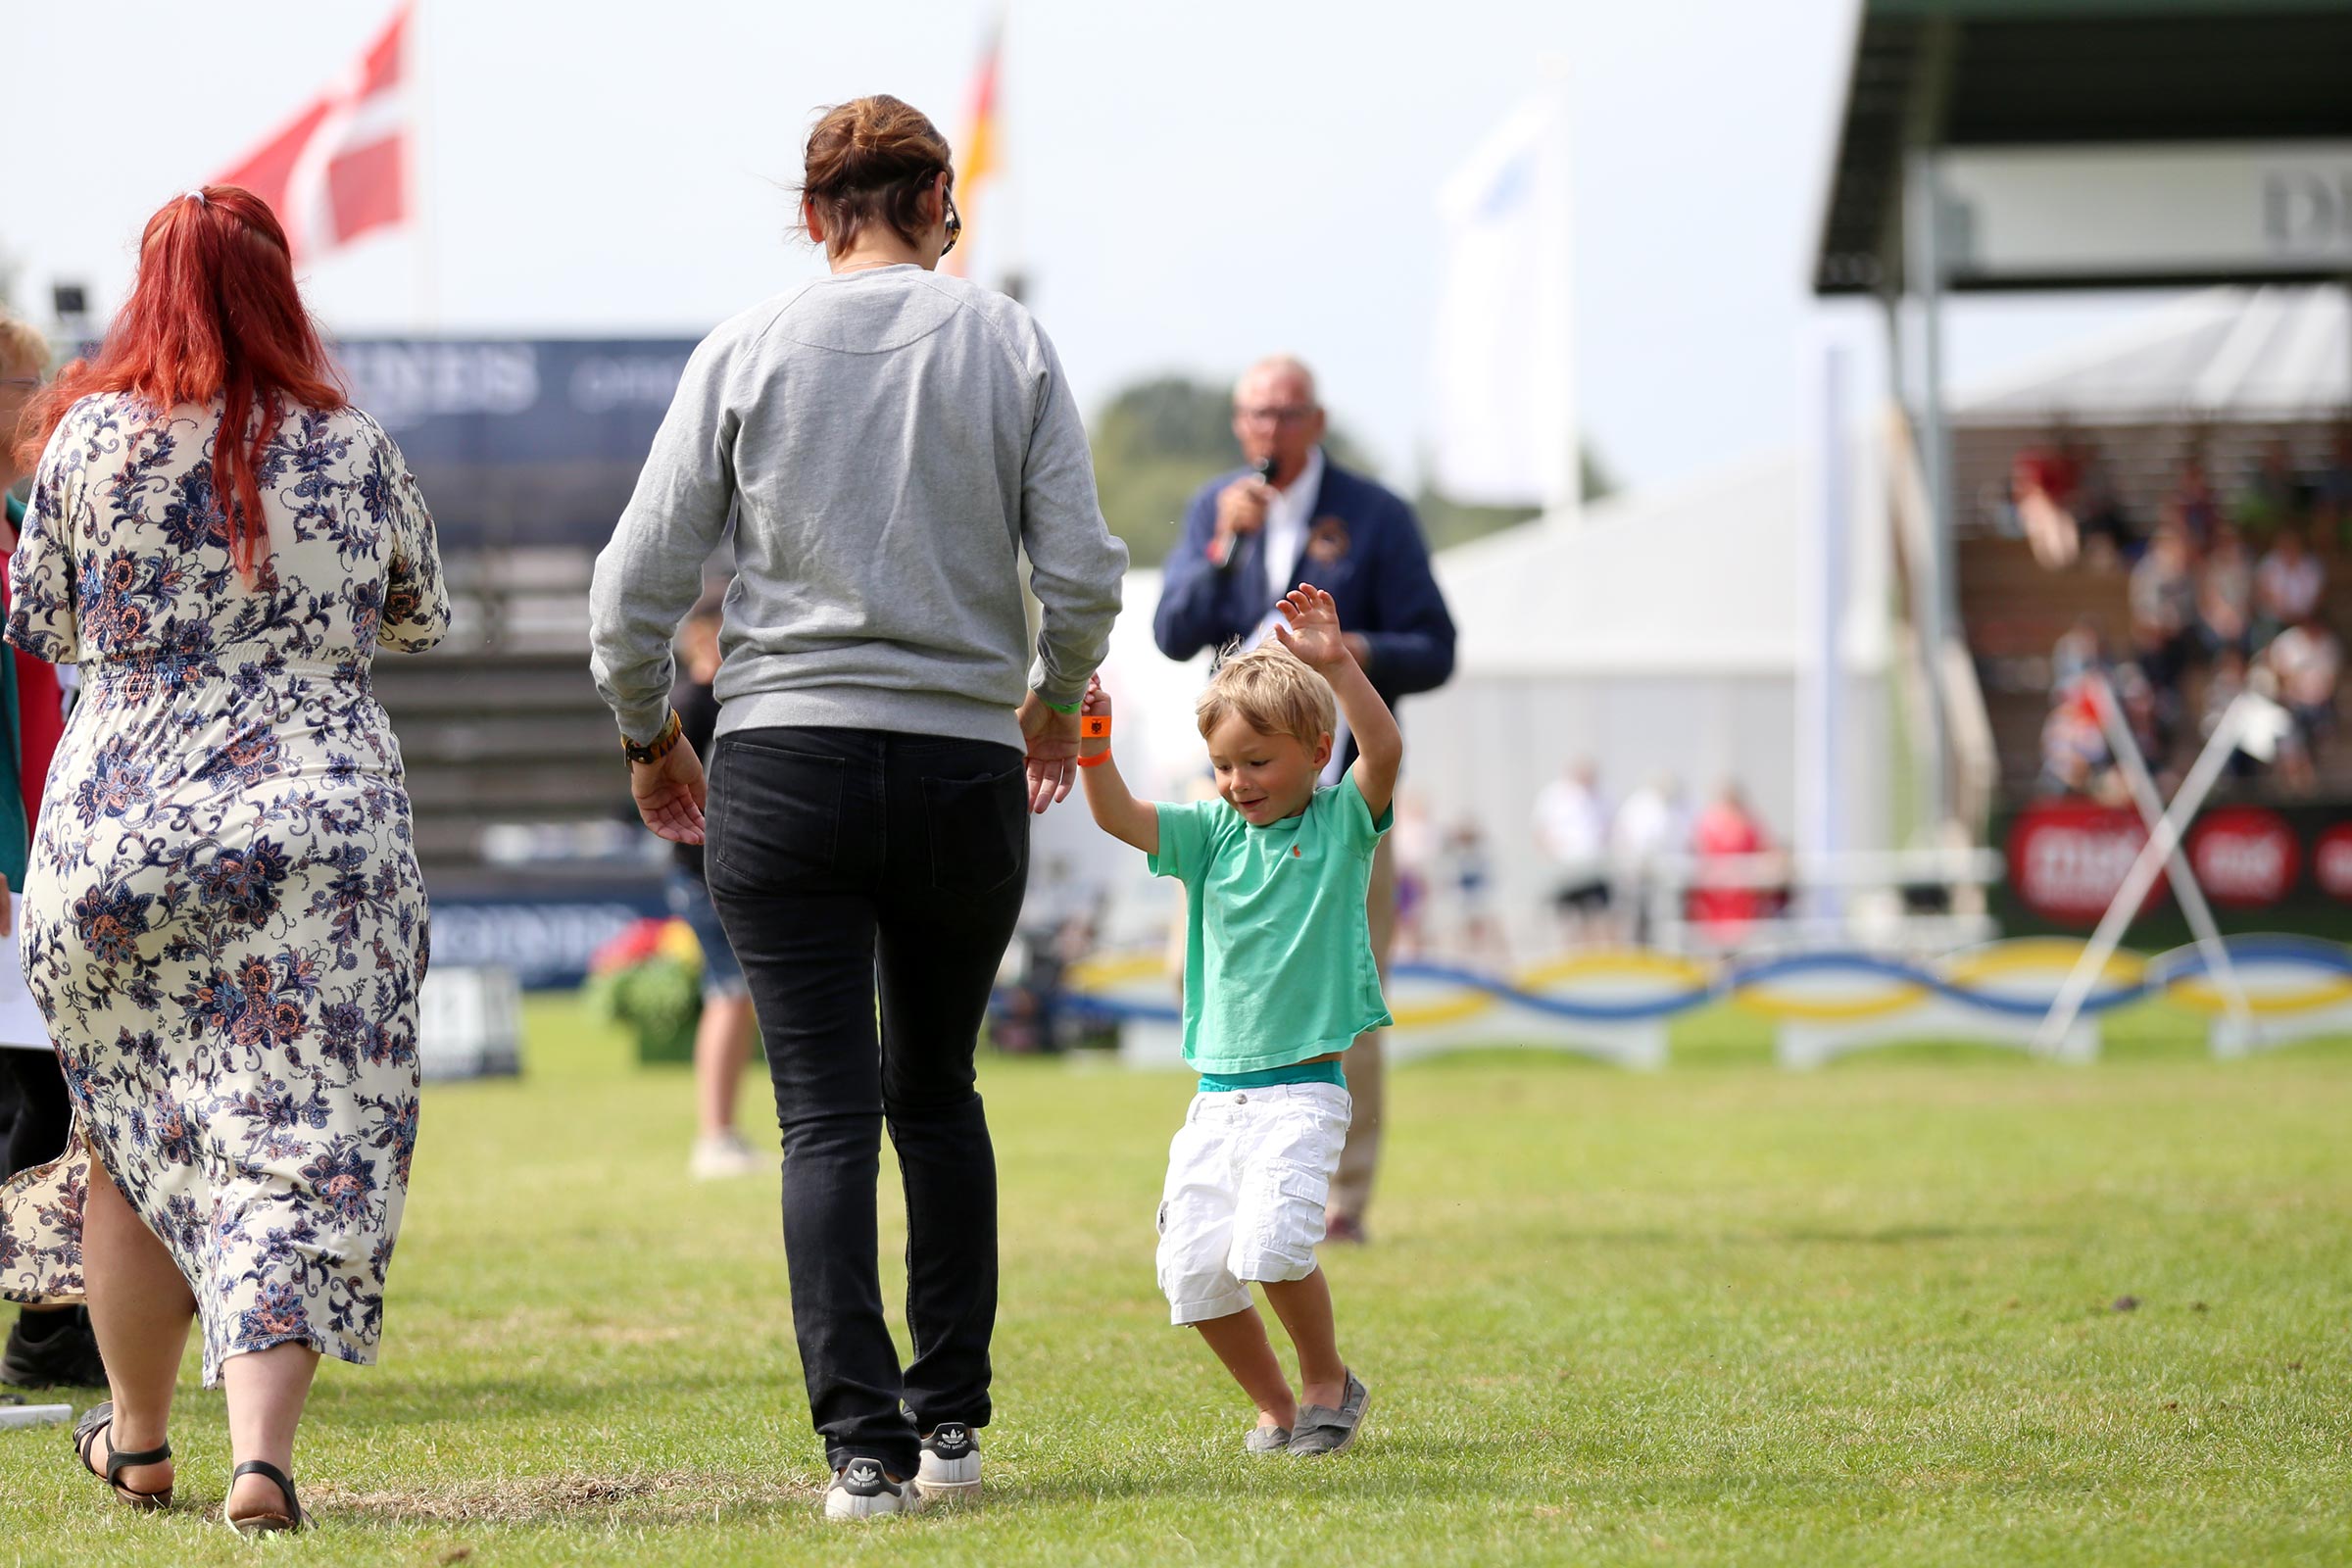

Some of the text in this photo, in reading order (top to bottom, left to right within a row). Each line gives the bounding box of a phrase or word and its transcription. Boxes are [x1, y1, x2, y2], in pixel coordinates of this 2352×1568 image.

[937, 1440, 969, 1450] stan smith
[847, 1477, 881, 1488] stan smith
